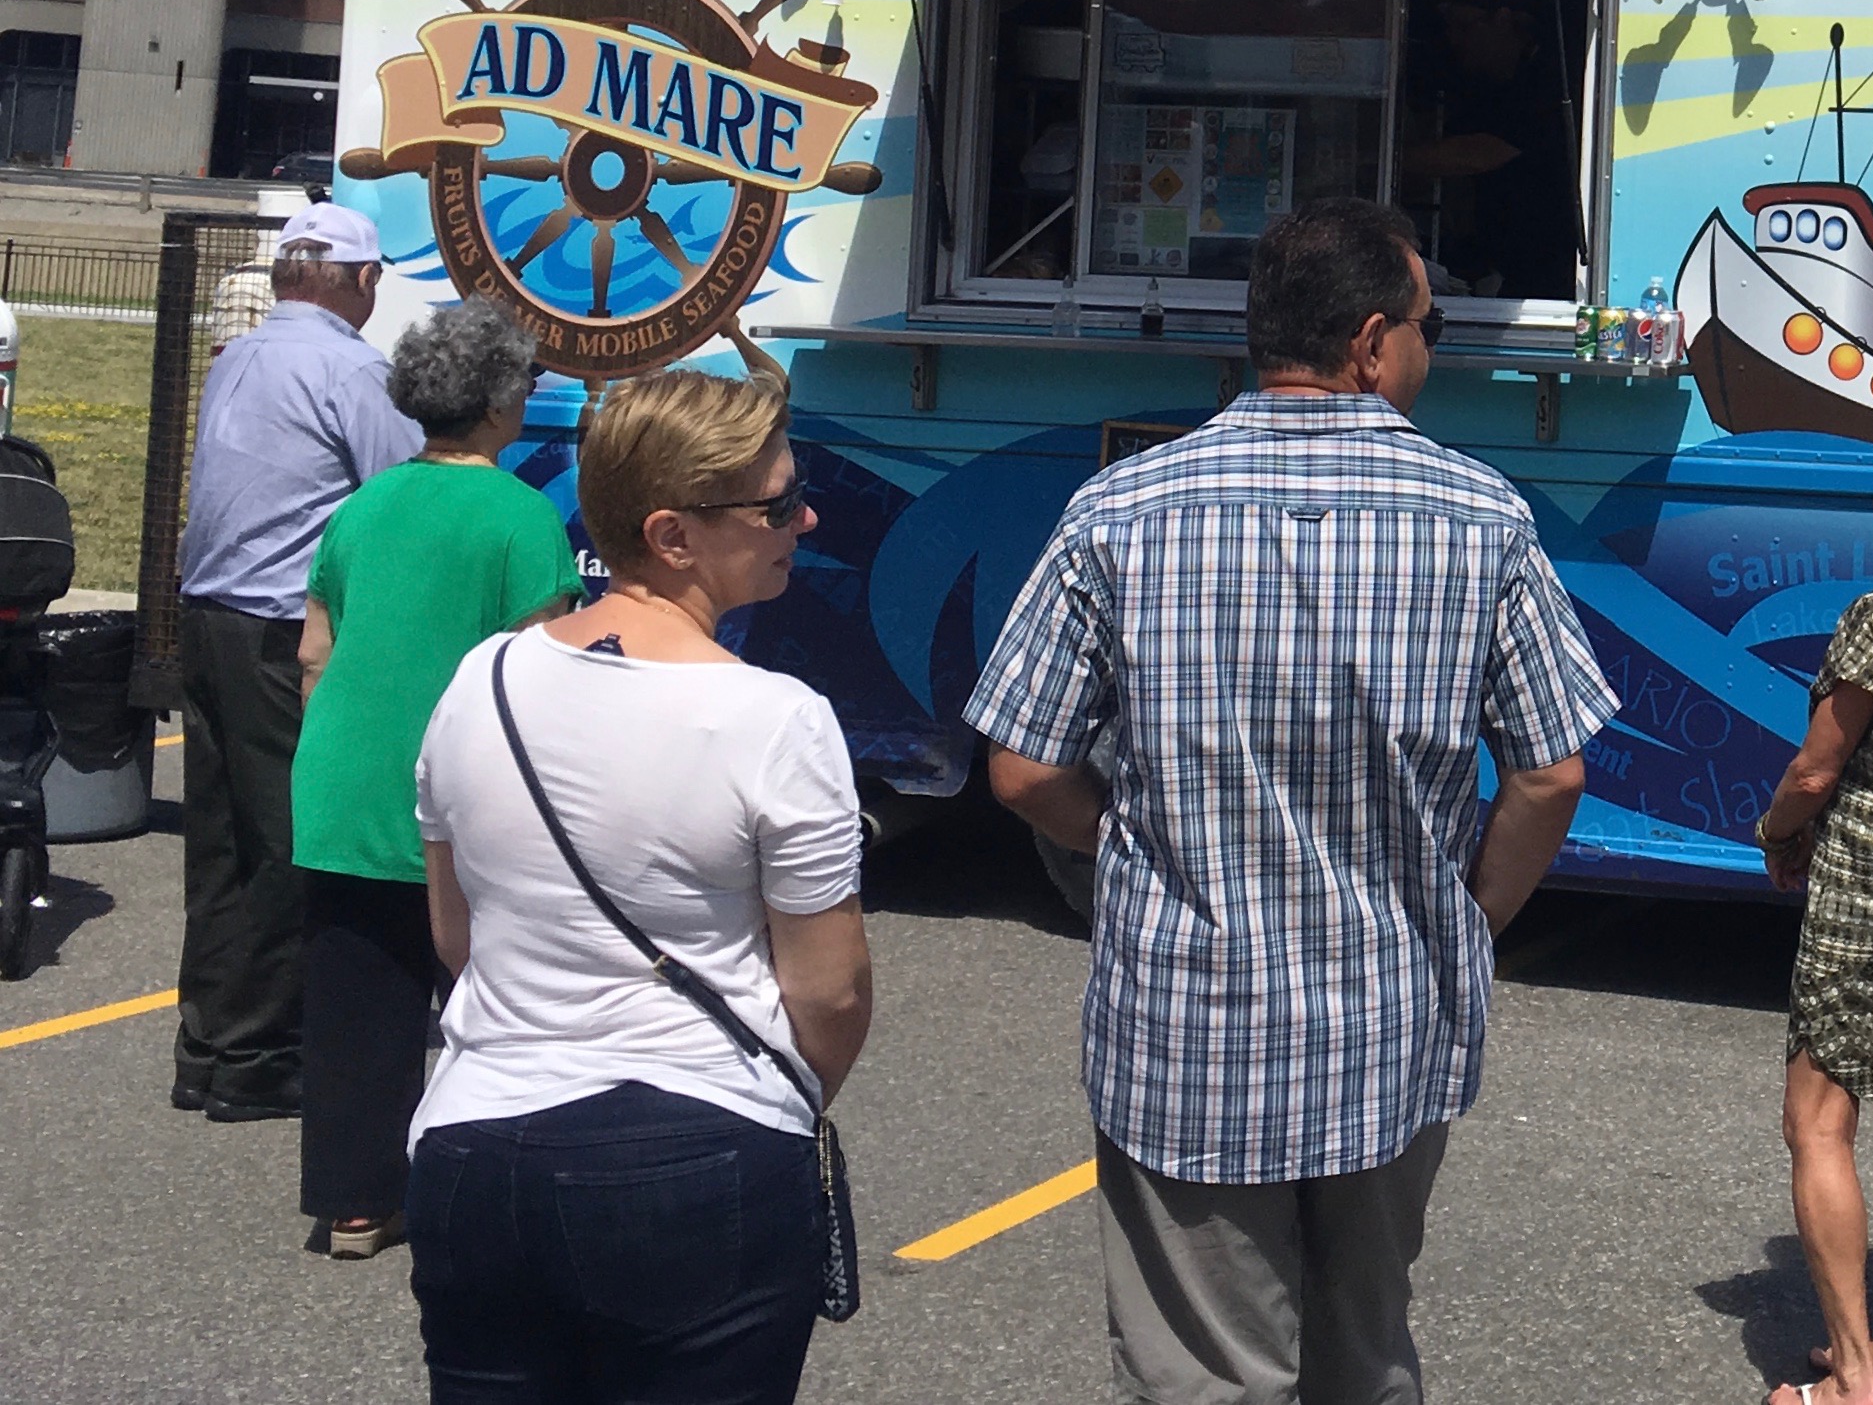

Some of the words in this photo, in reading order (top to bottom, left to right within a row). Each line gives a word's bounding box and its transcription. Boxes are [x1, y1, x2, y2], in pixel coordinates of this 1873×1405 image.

[456, 23, 567, 101] AD
[584, 40, 804, 181] MARE
[443, 165, 481, 267] FRUITS
[575, 316, 678, 358] MOBILE
[681, 201, 766, 326] SEAFOOD
[1707, 541, 1836, 598] Saint
[1602, 654, 1732, 750] ARIO
